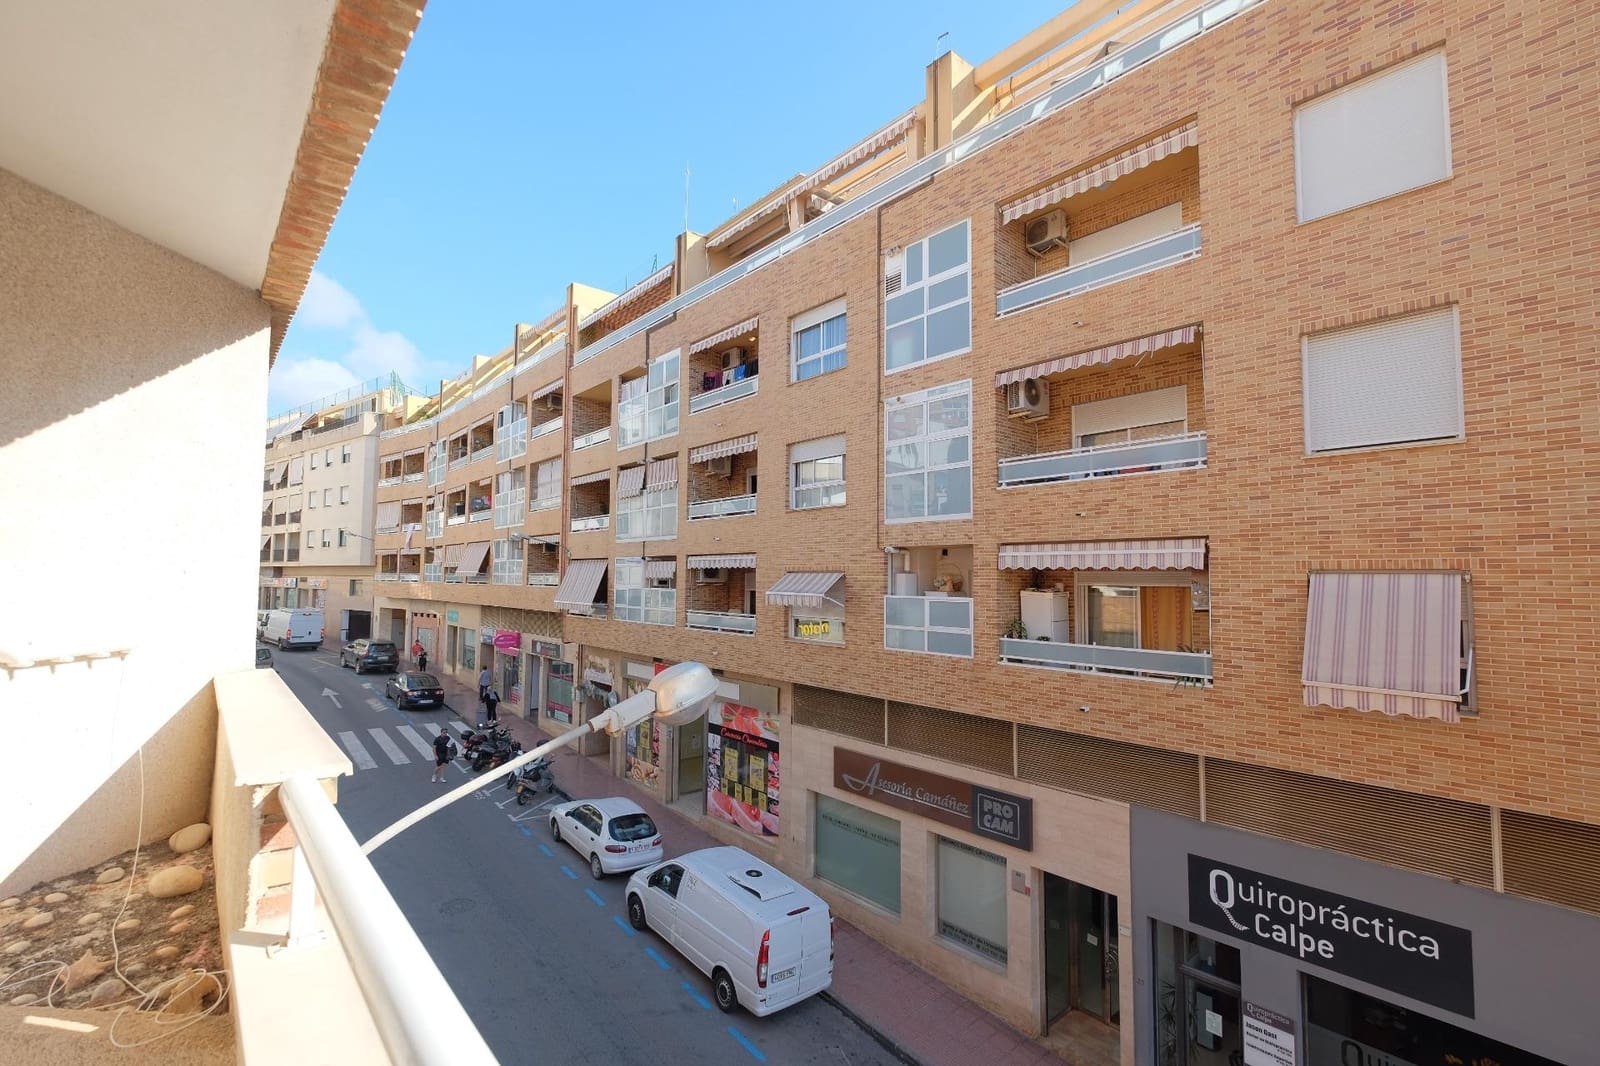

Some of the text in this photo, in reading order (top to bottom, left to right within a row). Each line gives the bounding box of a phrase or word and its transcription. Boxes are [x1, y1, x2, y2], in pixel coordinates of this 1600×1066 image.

[842, 762, 969, 814] Asesoría Camáñez
[983, 799, 1014, 819] PRO
[983, 814, 1014, 834] CAM
[1209, 869, 1440, 960] Quiropráctica
[1255, 913, 1334, 958] Calpe
